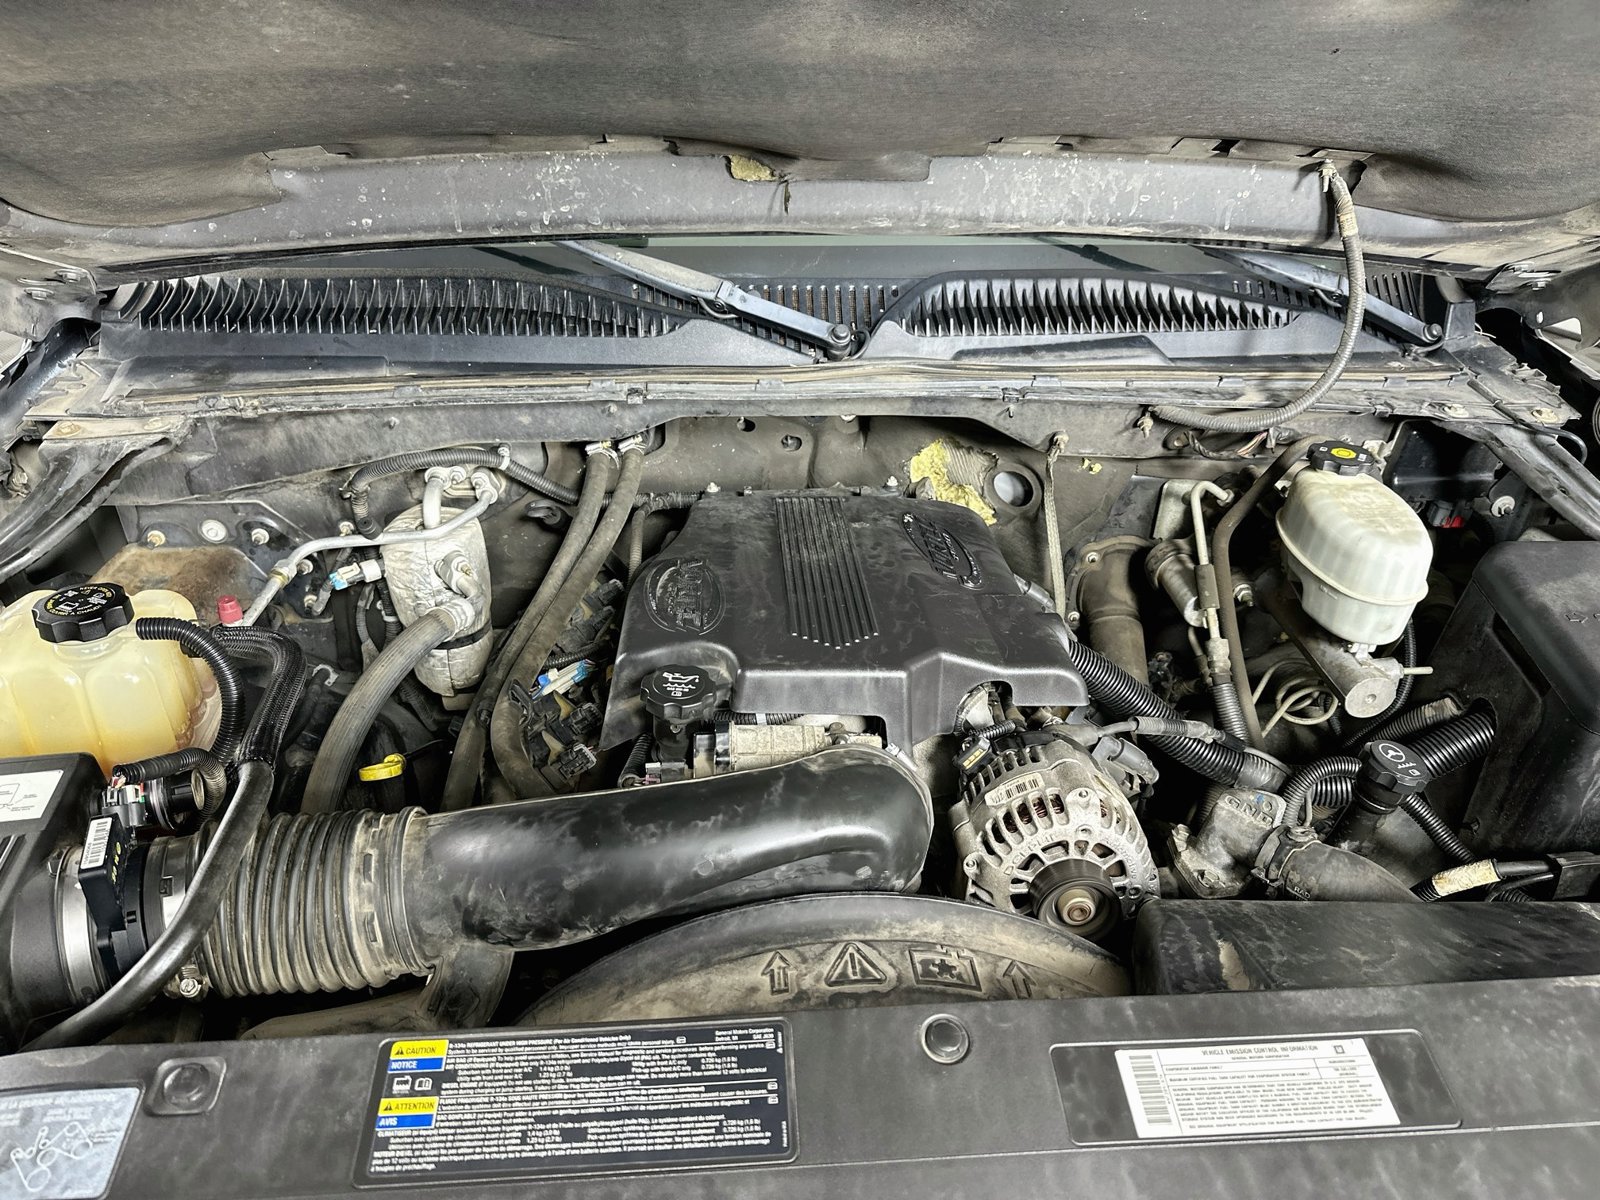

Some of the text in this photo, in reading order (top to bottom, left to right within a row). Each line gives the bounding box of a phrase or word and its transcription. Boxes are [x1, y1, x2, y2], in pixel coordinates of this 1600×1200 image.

[406, 1046, 437, 1055] CAUTION
[391, 1060, 418, 1069] NOTICE
[394, 1102, 434, 1110] ATTENTION
[379, 1117, 398, 1126] AVIS
